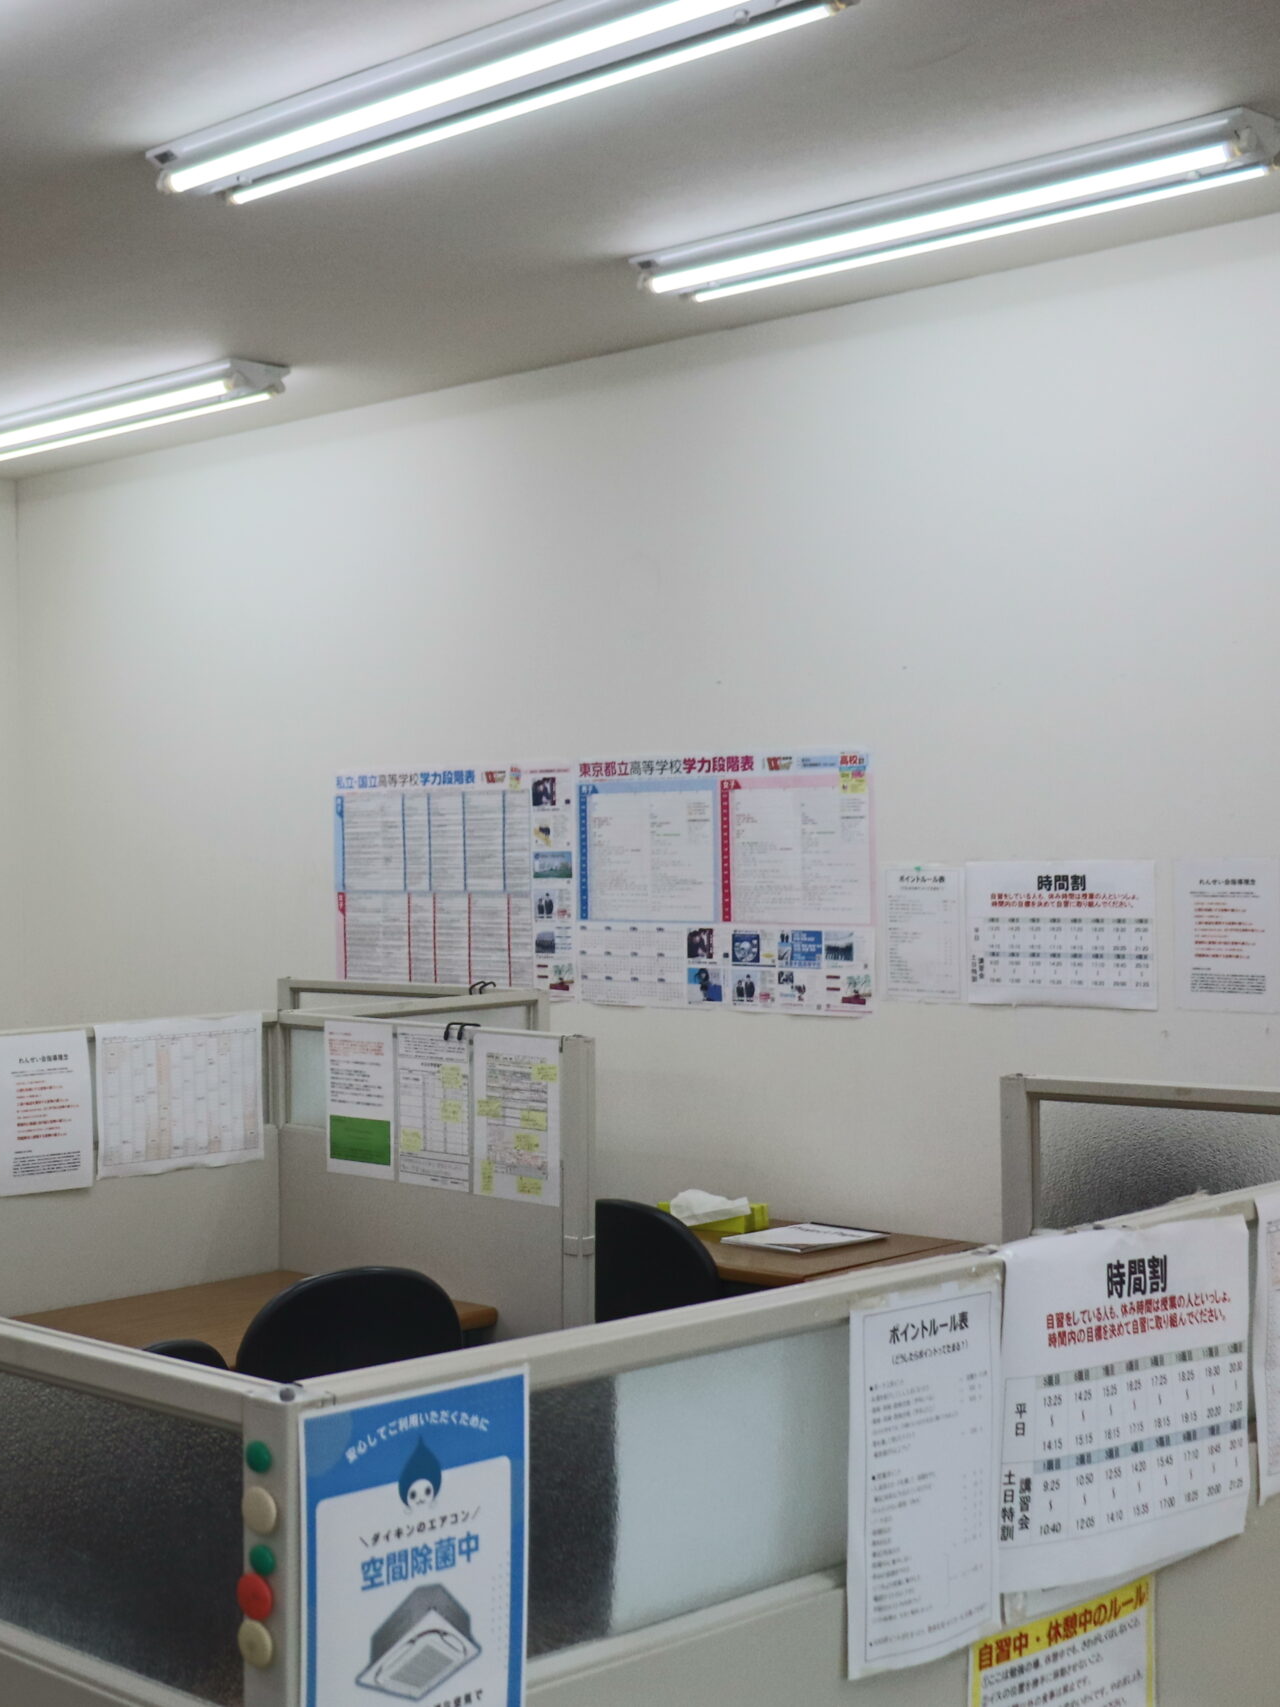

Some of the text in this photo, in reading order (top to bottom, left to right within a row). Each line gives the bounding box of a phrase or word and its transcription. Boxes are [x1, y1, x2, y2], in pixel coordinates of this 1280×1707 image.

[579, 756, 754, 777] 東京都立高等学校学力段階表
[1037, 875, 1086, 891] 時間割
[1106, 1254, 1168, 1299] 時間割
[889, 1311, 969, 1344] ポイントルール表
[1047, 1309, 1226, 1348] 時間内の目標を決めて自習に取り組んでください。
[1043, 1394, 1062, 1408] 13:25
[1074, 1389, 1092, 1401] 14:25
[1151, 1374, 1168, 1387] 17:25
[345, 1409, 491, 1464] 安心してご利用いただくために
[1015, 1403, 1027, 1436] 平日
[1043, 1438, 1062, 1452] 14:15
[1075, 1432, 1093, 1446] 15:15
[1129, 1421, 1144, 1433] 17:15
[1043, 1478, 1060, 1492] 9:25
[1076, 1472, 1093, 1486] 10:50
[1157, 1455, 1173, 1468] 15:45
[1184, 1449, 1199, 1461] 17:10
[1000, 1470, 1016, 1541] 土日特訓
[1018, 1477, 1032, 1531] 講習会
[1040, 1522, 1061, 1536] 10:40
[1076, 1516, 1095, 1530] 12:05
[1107, 1510, 1123, 1524] 14:10
[1160, 1497, 1175, 1510] 17:00
[372, 1510, 470, 1546] ダイキンのエアコン
[361, 1531, 479, 1592] 空間除菌中
